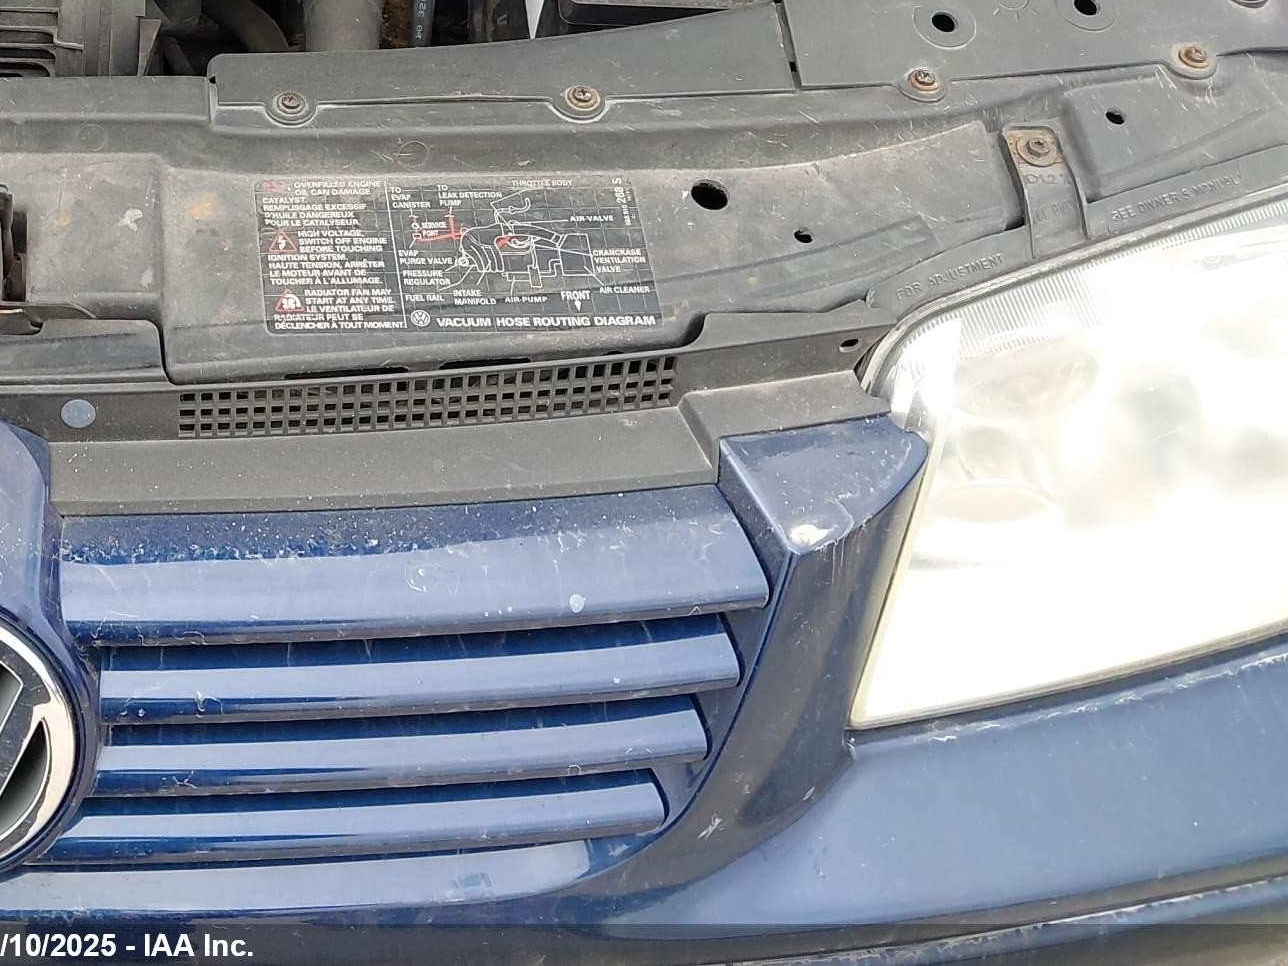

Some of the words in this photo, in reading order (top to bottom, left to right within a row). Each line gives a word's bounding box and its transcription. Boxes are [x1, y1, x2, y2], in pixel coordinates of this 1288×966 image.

[294, 181, 346, 189] OVERFILLED
[512, 179, 550, 187] THROTTLE
[458, 191, 503, 199] DETECTION
[263, 204, 324, 212] REMPLISSAGE
[325, 203, 367, 211] EXCESSIF
[299, 211, 355, 219] DANGEREUX
[421, 221, 447, 229] SERVICE
[298, 237, 334, 245] SWITCH
[335, 237, 353, 245] OFF
[354, 237, 387, 245] ENGINE
[300, 245, 335, 253] BEFORE
[268, 254, 307, 262] IGNITION
[399, 257, 426, 265] PURGE
[427, 257, 452, 265] VALVE
[594, 256, 646, 264] VENTILATION
[269, 262, 300, 270] HAUTE
[596, 265, 621, 273] VALVE
[928, 253, 1003, 287] ADJUSTMENT
[282, 269, 320, 277] MOTEUR
[323, 269, 352, 277] AVANT
[403, 269, 443, 277] PRESSURE
[404, 278, 451, 286] REGULATOR
[304, 288, 350, 296] RADIATOR
[351, 288, 370, 296] FAN
[371, 288, 392, 296] MAY
[599, 286, 612, 294] AIR
[613, 285, 650, 293] CLEANER
[426, 294, 445, 302] RAIL
[561, 290, 591, 301] FRONT
[305, 296, 333, 304] START
[350, 296, 370, 304] ANY
[320, 304, 381, 312] VENTILATEUR
[273, 313, 325, 321] RADIATEUR
[326, 313, 350, 321] PEUT
[436, 317, 491, 327] VACUUM
[496, 317, 531, 327] HOSE
[532, 316, 590, 327] ROUTING
[593, 315, 656, 326] DIAGRAM
[339, 321, 363, 329] TOUT
